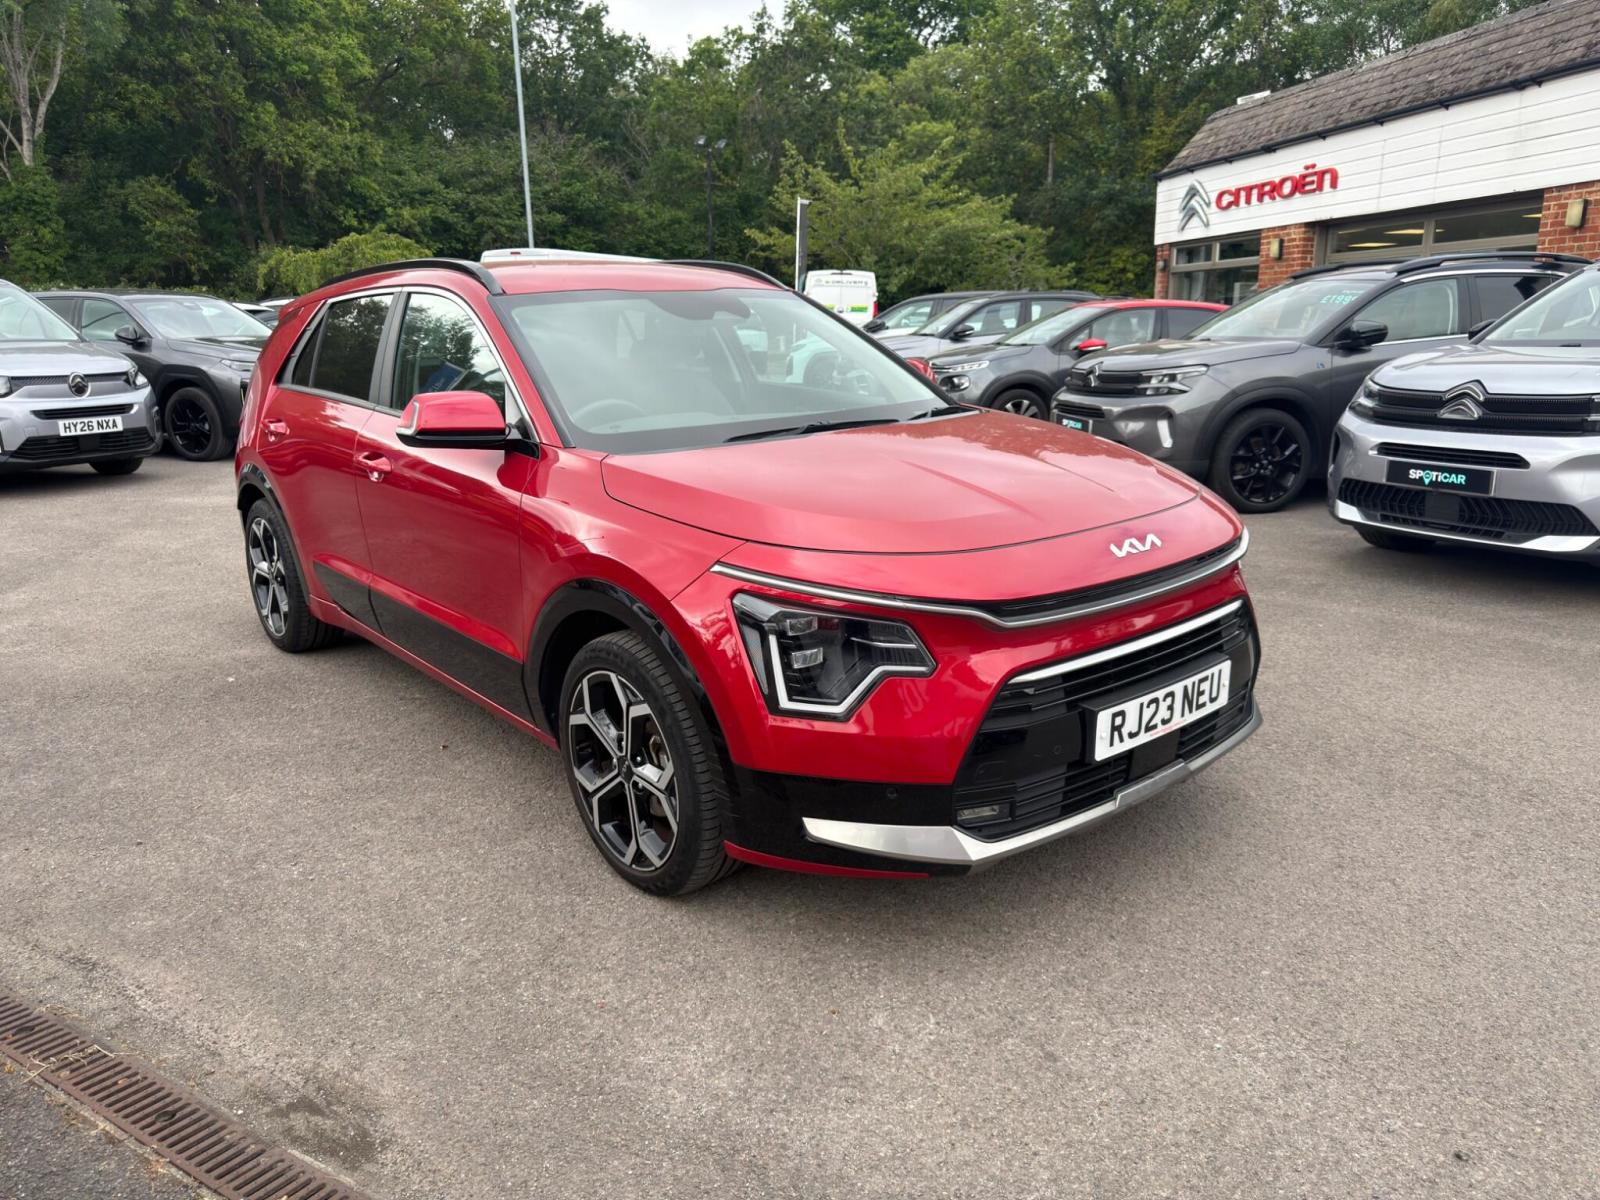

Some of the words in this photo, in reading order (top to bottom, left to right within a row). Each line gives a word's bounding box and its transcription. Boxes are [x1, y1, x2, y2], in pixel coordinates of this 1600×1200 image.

[63, 420, 95, 434] HY26
[97, 418, 118, 431] NXA
[1109, 533, 1162, 558] KIA
[1109, 691, 1176, 748] RJ23
[1181, 669, 1223, 718] NEU
